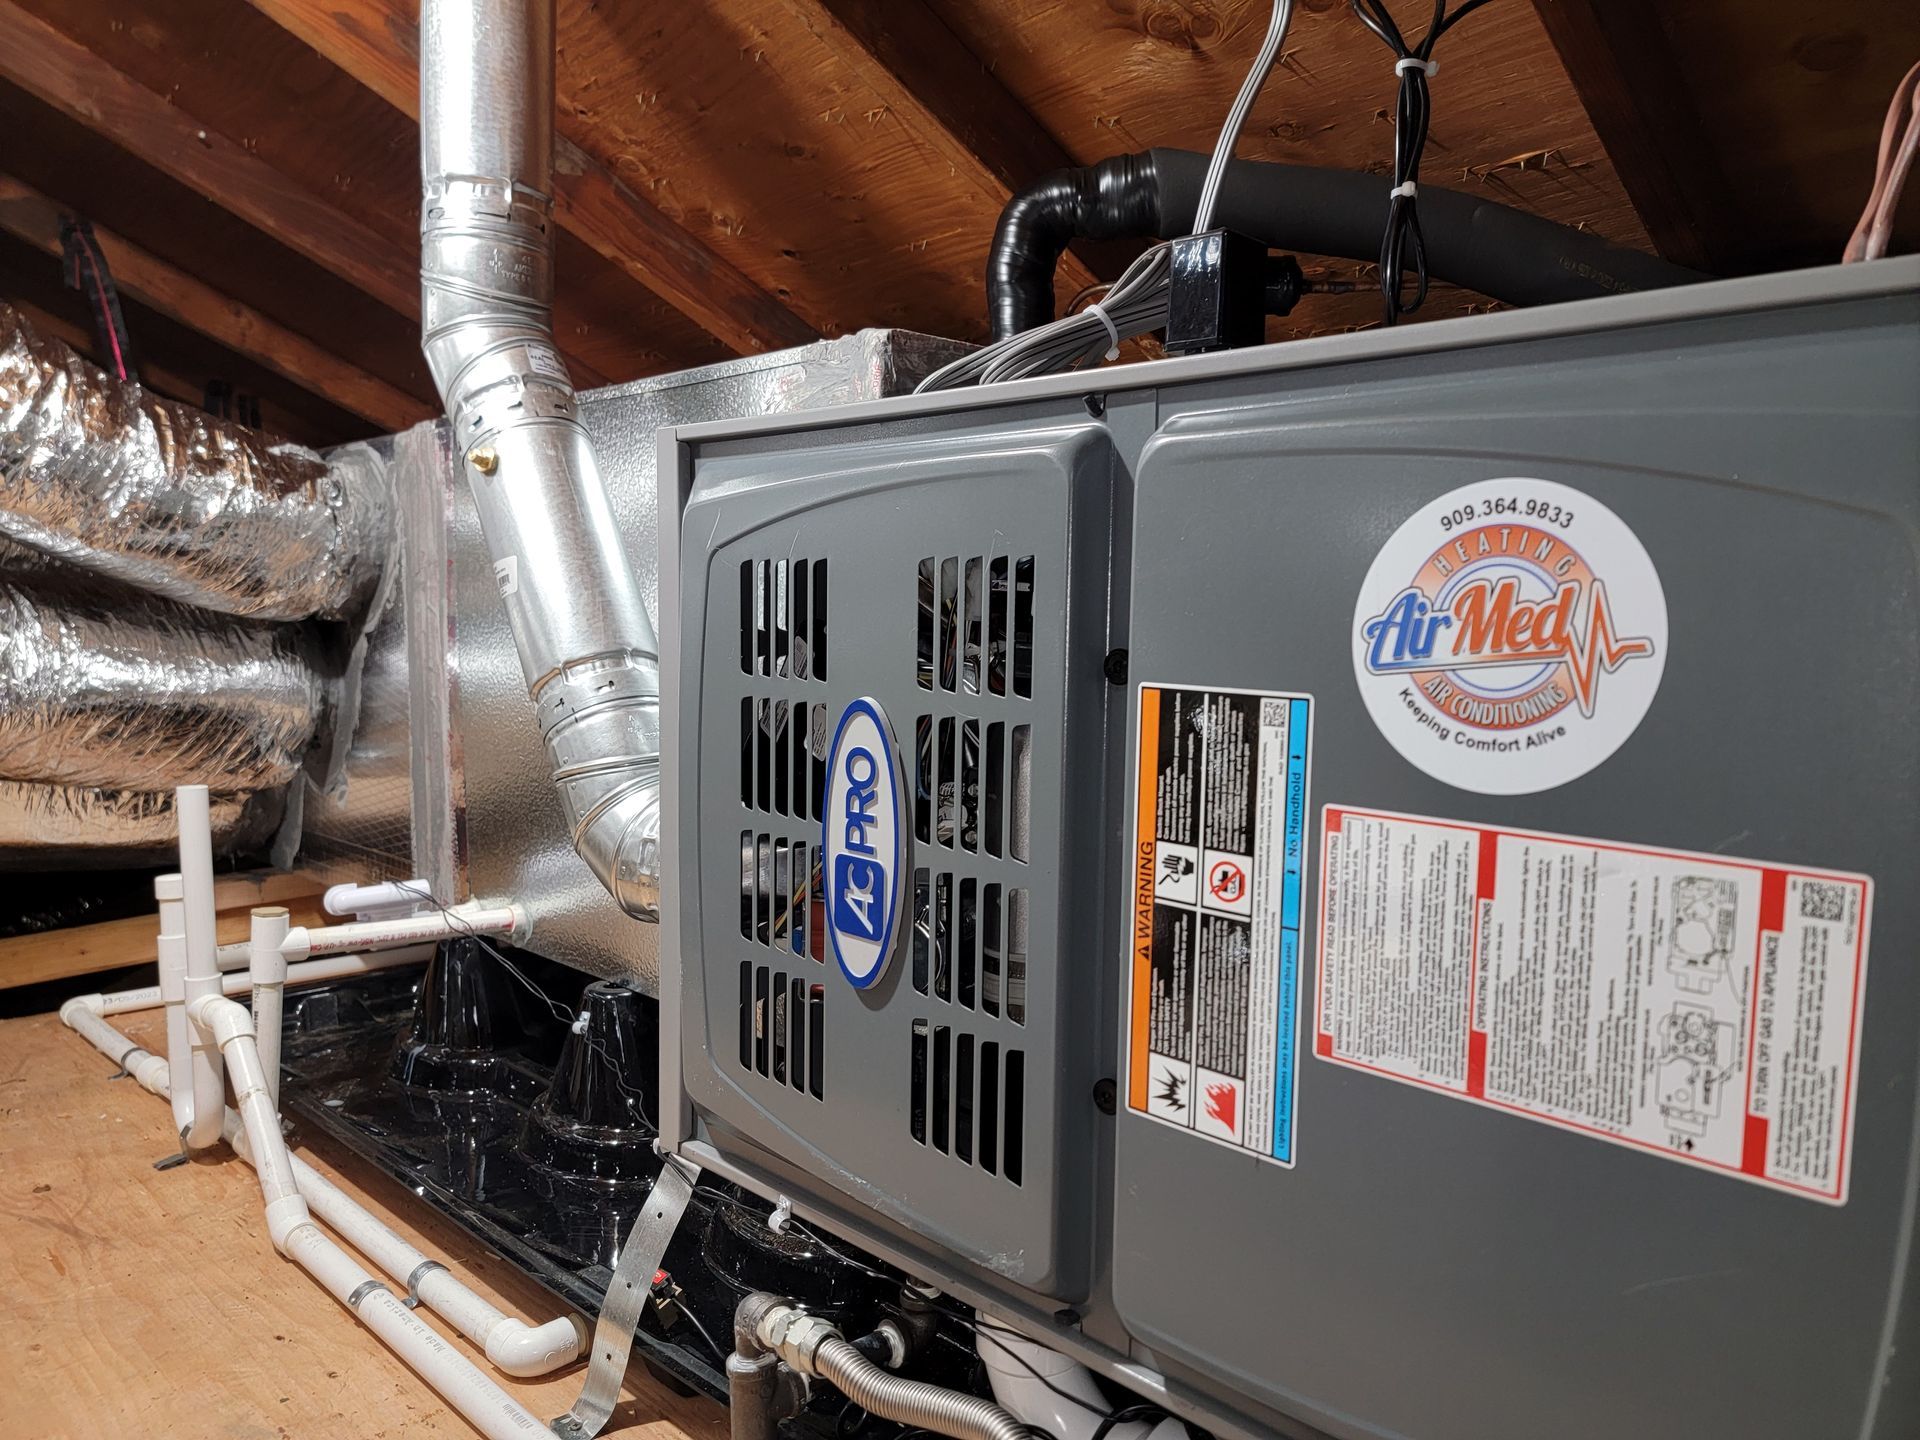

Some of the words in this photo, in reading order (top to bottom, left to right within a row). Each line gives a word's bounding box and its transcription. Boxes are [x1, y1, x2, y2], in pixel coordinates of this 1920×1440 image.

[1440, 497, 1575, 531] 909.364.9833
[1433, 529, 1578, 576] HEATING
[1424, 675, 1453, 708] AIR
[1450, 682, 1568, 728] CONDITIONING
[1398, 687, 1450, 741] Keeping
[1454, 730, 1521, 753] Comfort
[1525, 724, 1567, 749] Alive
[1288, 771, 1300, 835] Handhold
[1287, 839, 1298, 857] No
[1328, 834, 1338, 886] OPERATING
[1137, 839, 1153, 940] WARNING
[1327, 887, 1336, 922] BEFORE
[1326, 924, 1335, 949] READ
[1478, 900, 1492, 972] INSTRUCTIONS
[1324, 951, 1334, 984] SAFETY
[1761, 934, 1779, 996] APPLIANCE
[1323, 985, 1332, 1011] YOUR
[1475, 974, 1488, 1030] OPERATING
[1760, 997, 1774, 1014] TO
[1322, 1012, 1331, 1031] FOR
[1758, 1016, 1773, 1040] GAS
[1756, 1041, 1771, 1064] OFF
[1754, 1064, 1769, 1096] TURN
[1753, 1096, 1767, 1113] TO
